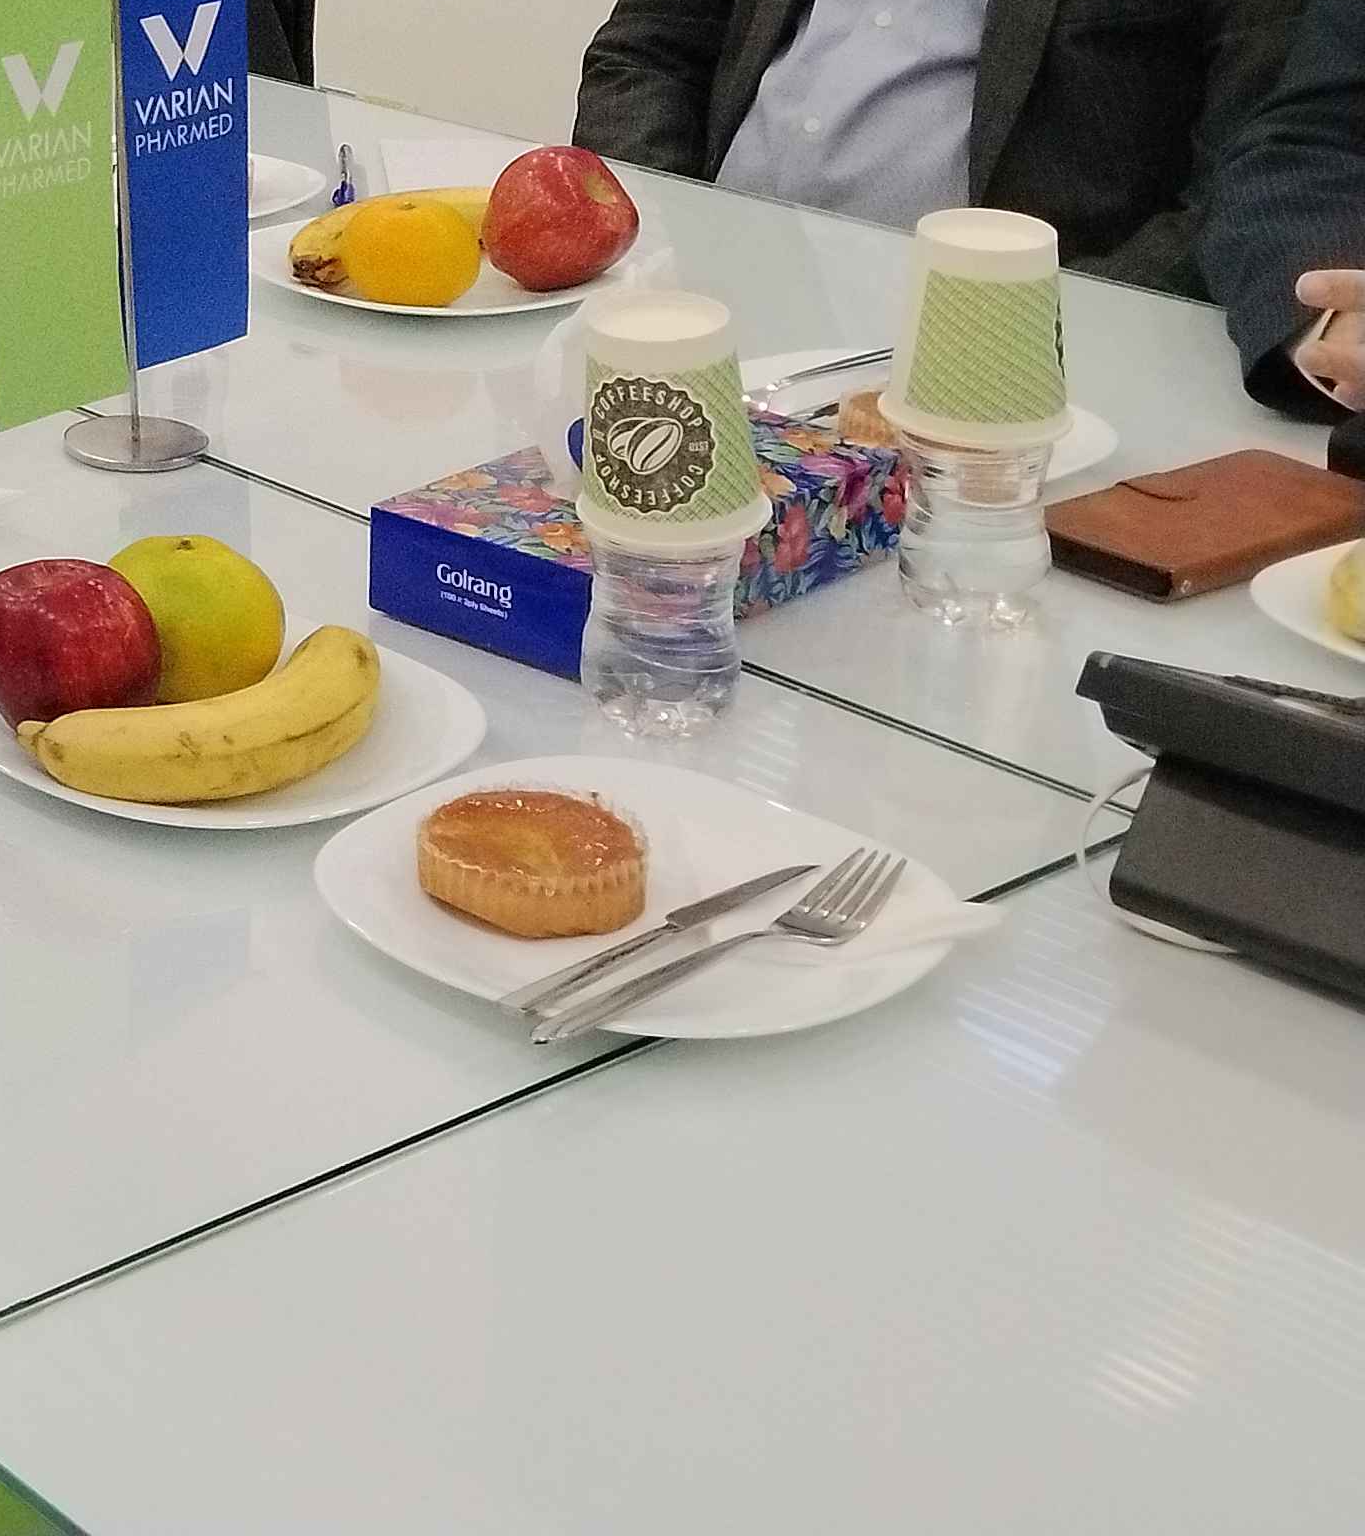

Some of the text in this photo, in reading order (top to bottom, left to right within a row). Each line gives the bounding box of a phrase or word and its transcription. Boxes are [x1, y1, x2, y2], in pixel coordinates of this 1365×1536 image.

[134, 77, 234, 126] VARIAN
[135, 113, 233, 157] PHARMED
[594, 385, 703, 427] COFFEESHOP
[595, 453, 704, 506] COFFEESHOP
[436, 563, 513, 609] Golrang
